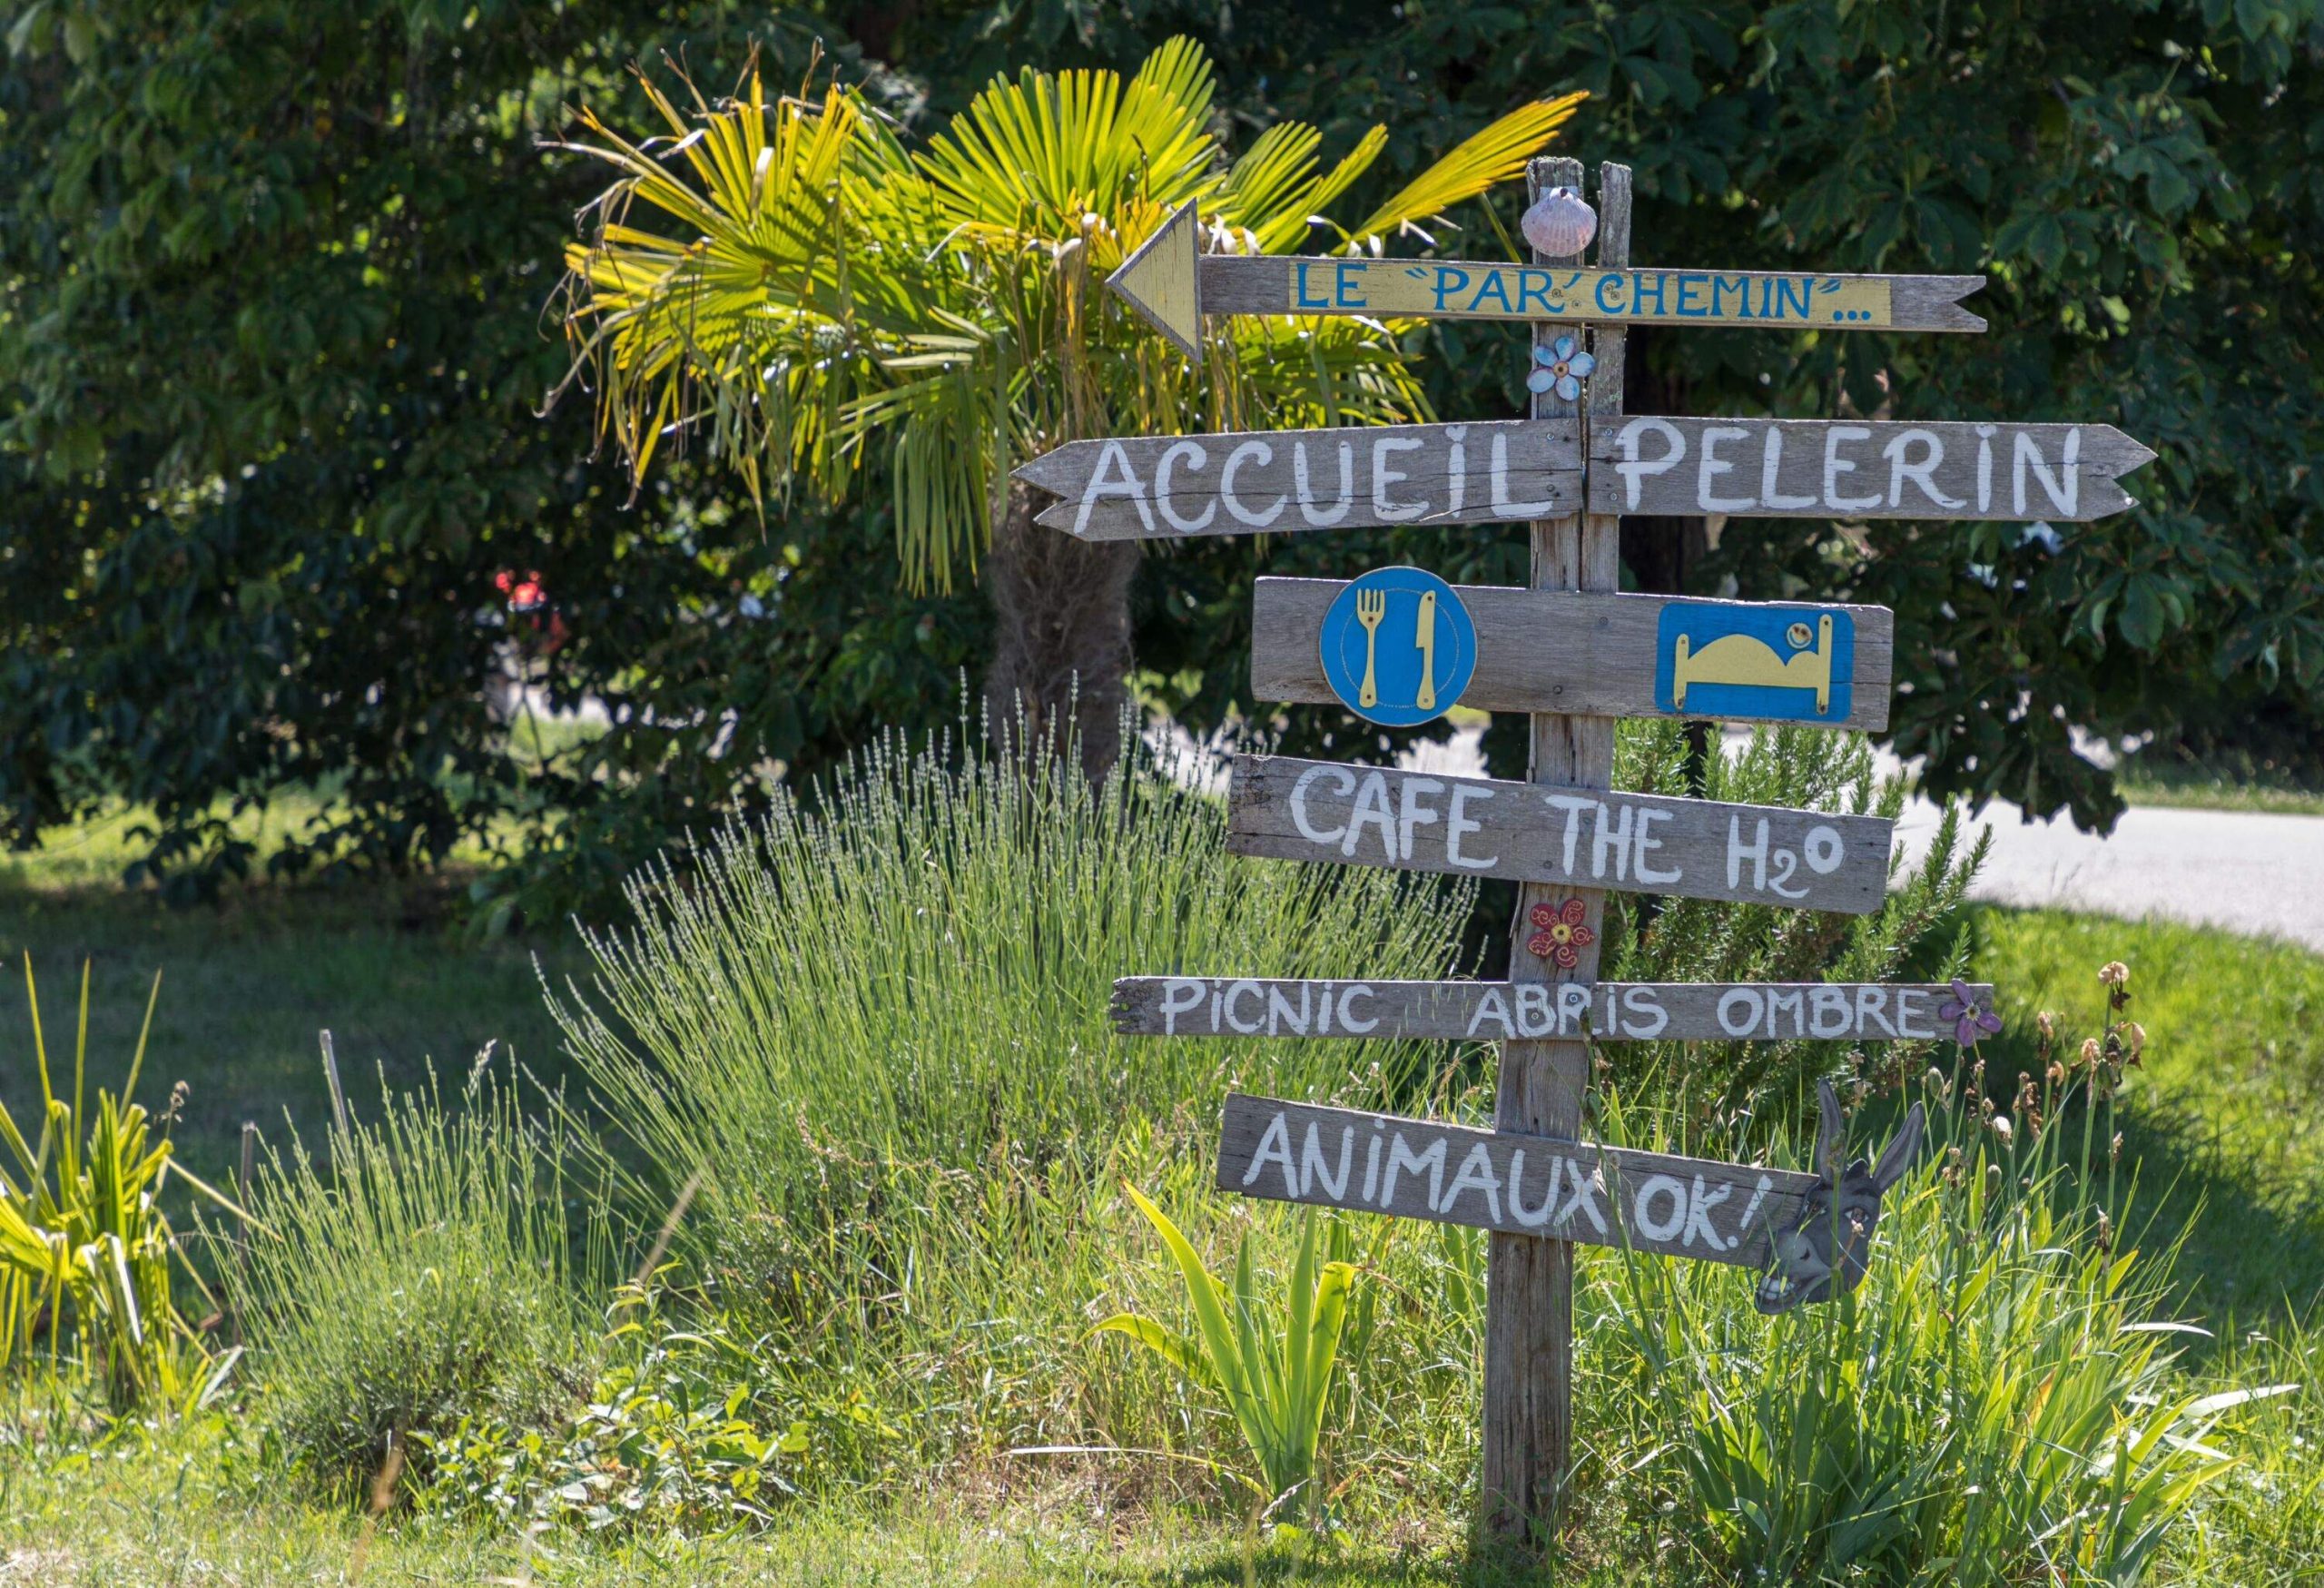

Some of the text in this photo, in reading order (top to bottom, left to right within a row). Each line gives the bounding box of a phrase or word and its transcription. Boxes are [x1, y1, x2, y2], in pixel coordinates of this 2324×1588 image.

[1296, 262, 1367, 308] LE
[1289, 764, 1499, 869] CAFE
[1545, 795, 1682, 884] THE
[1717, 988, 1936, 1039] OMBRE
[1637, 1174, 1774, 1251] OK!
